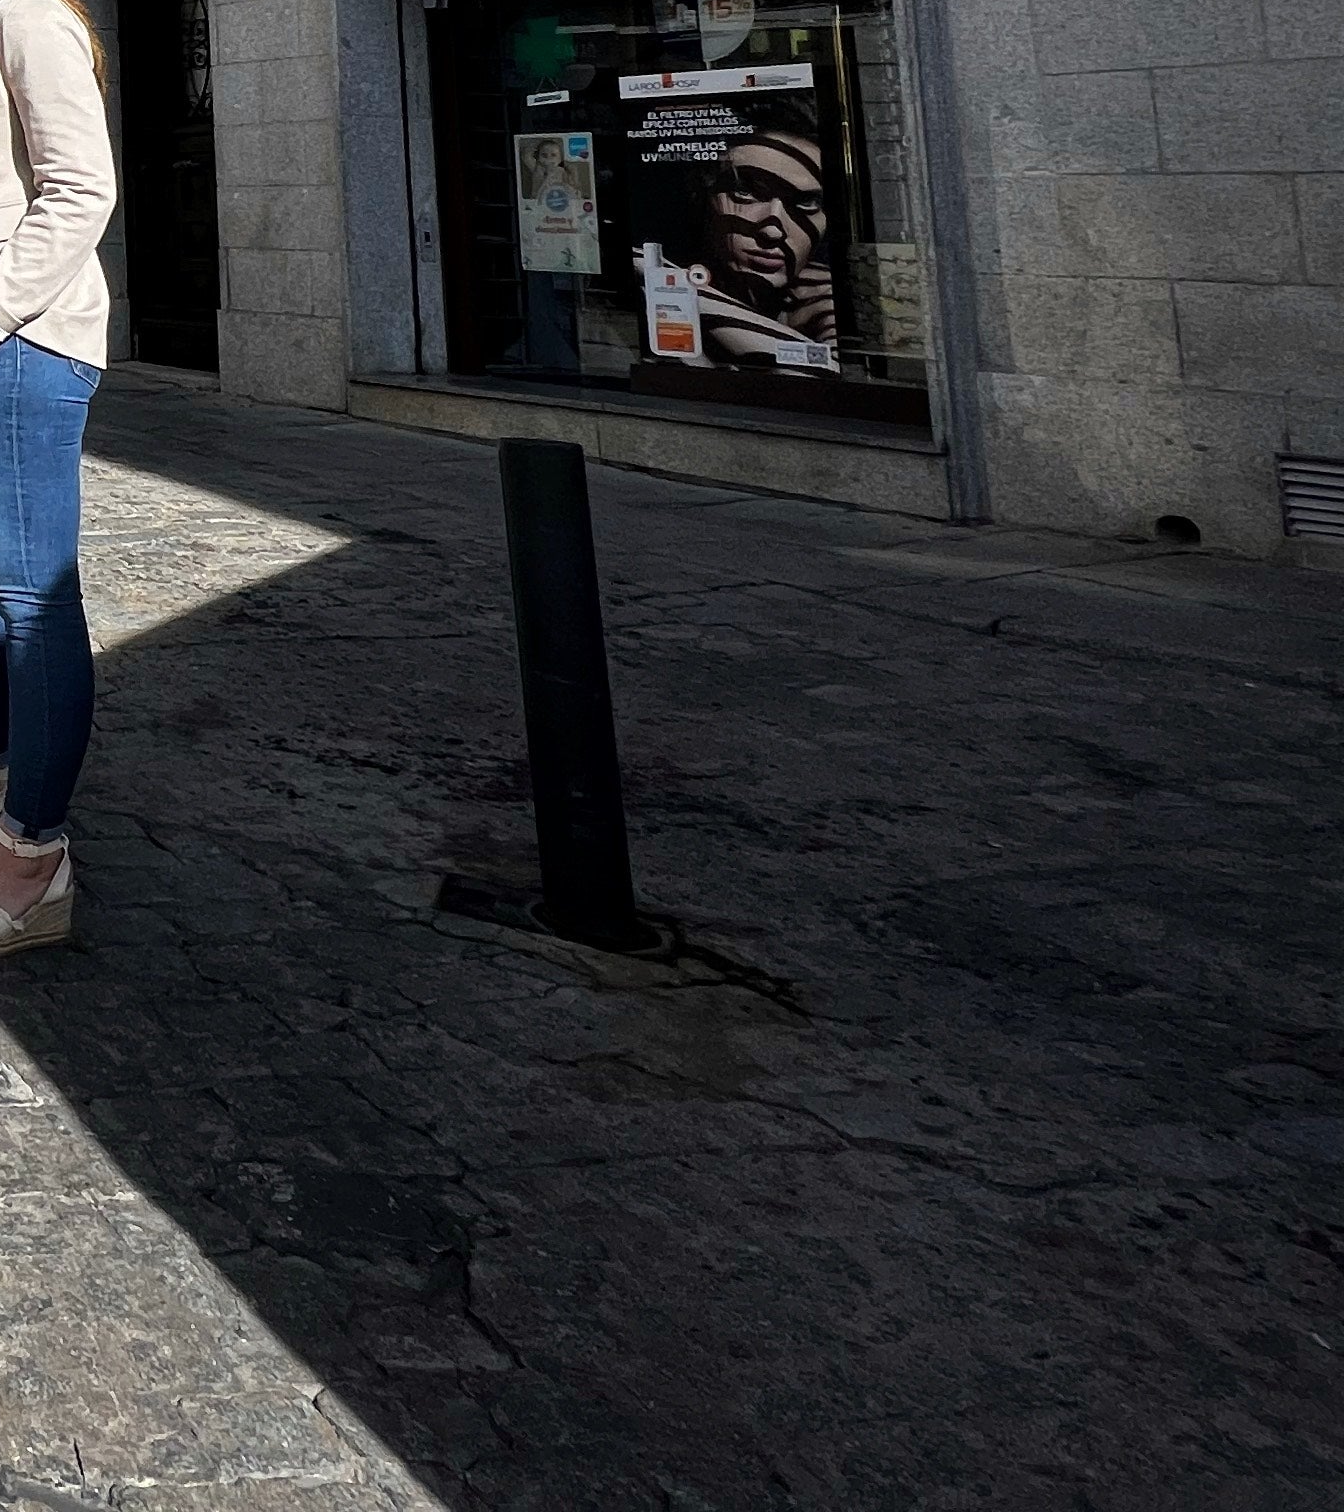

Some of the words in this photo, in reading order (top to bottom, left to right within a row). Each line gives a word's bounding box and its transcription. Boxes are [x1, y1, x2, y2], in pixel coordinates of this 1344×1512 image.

[719, 116, 739, 126] LOS
[658, 140, 728, 153] ANTHELIOS
[693, 151, 719, 161] 400
